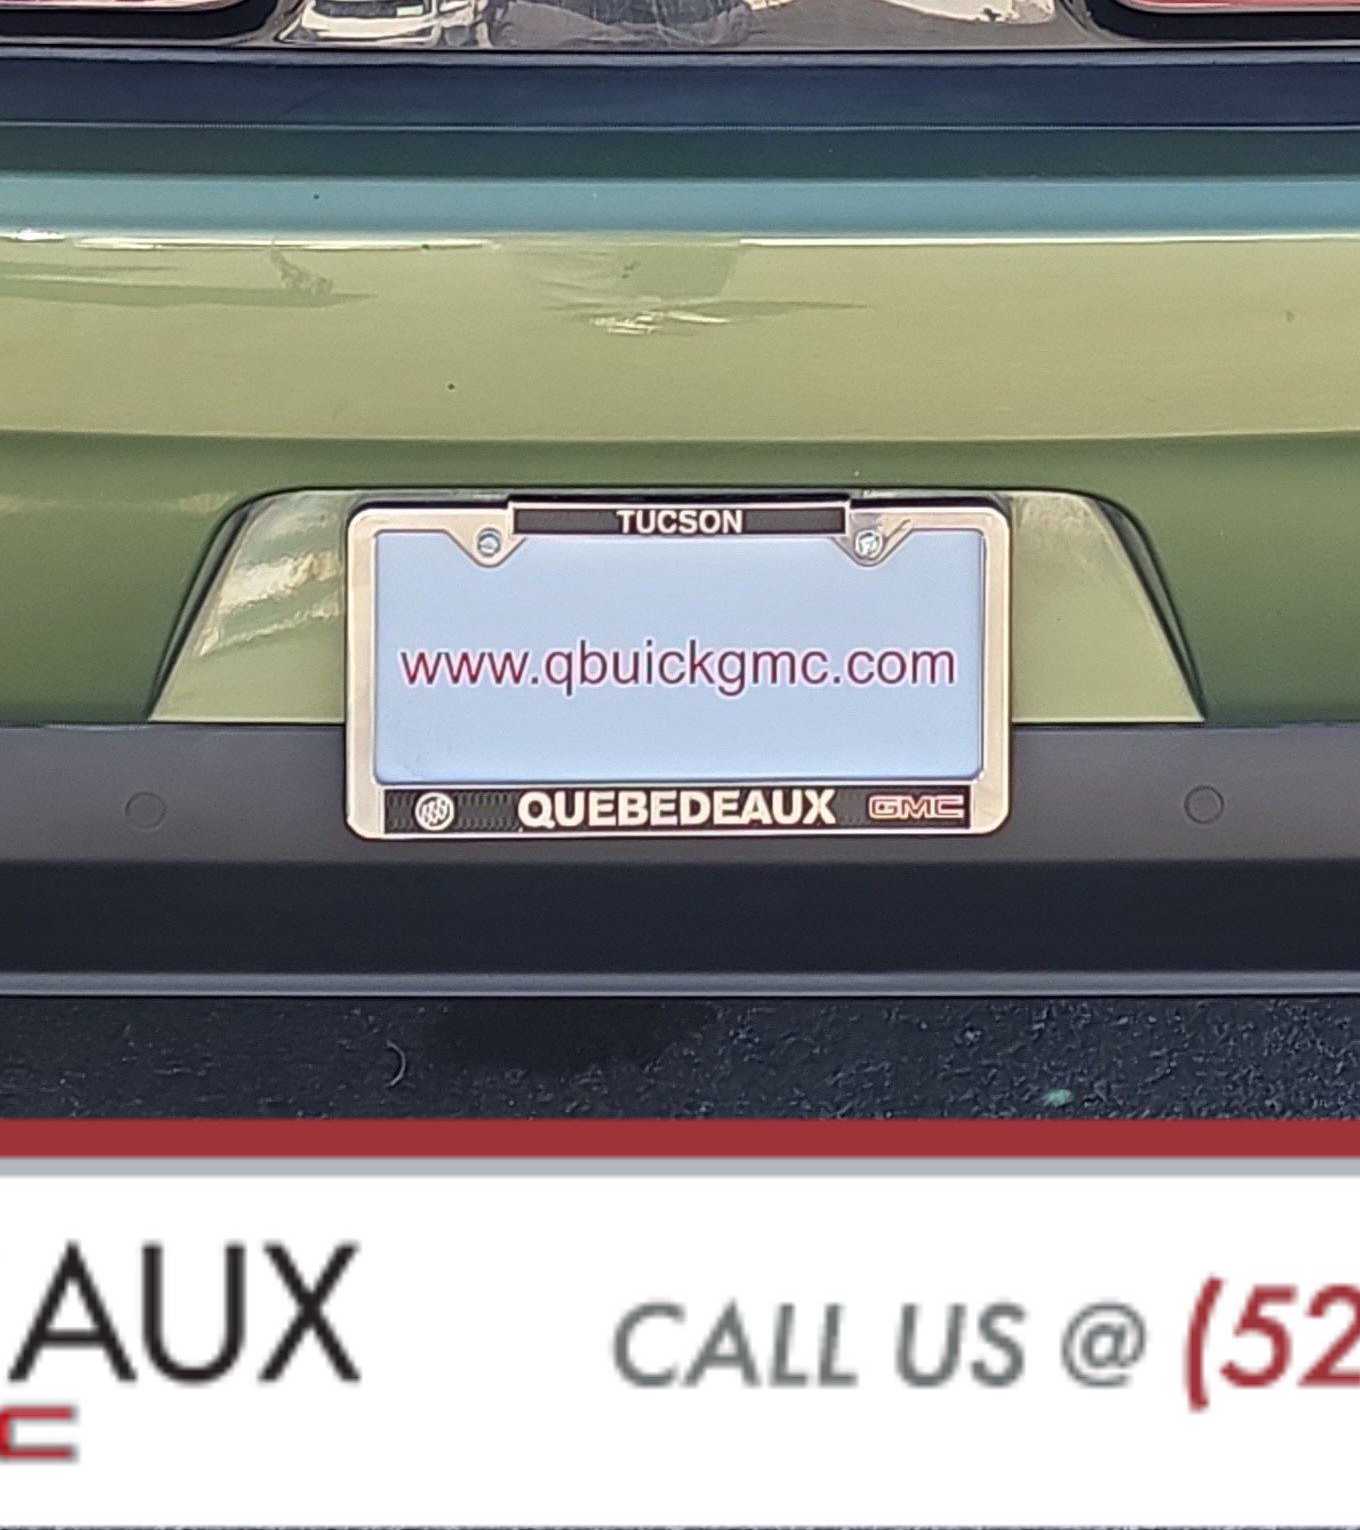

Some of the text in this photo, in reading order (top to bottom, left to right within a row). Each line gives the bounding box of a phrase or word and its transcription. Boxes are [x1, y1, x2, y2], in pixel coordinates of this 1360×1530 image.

[615, 509, 743, 534] TUCSON
[401, 639, 956, 697] www.qbuickgmc.com
[517, 789, 965, 828] QUEBEDEAUX GMC
